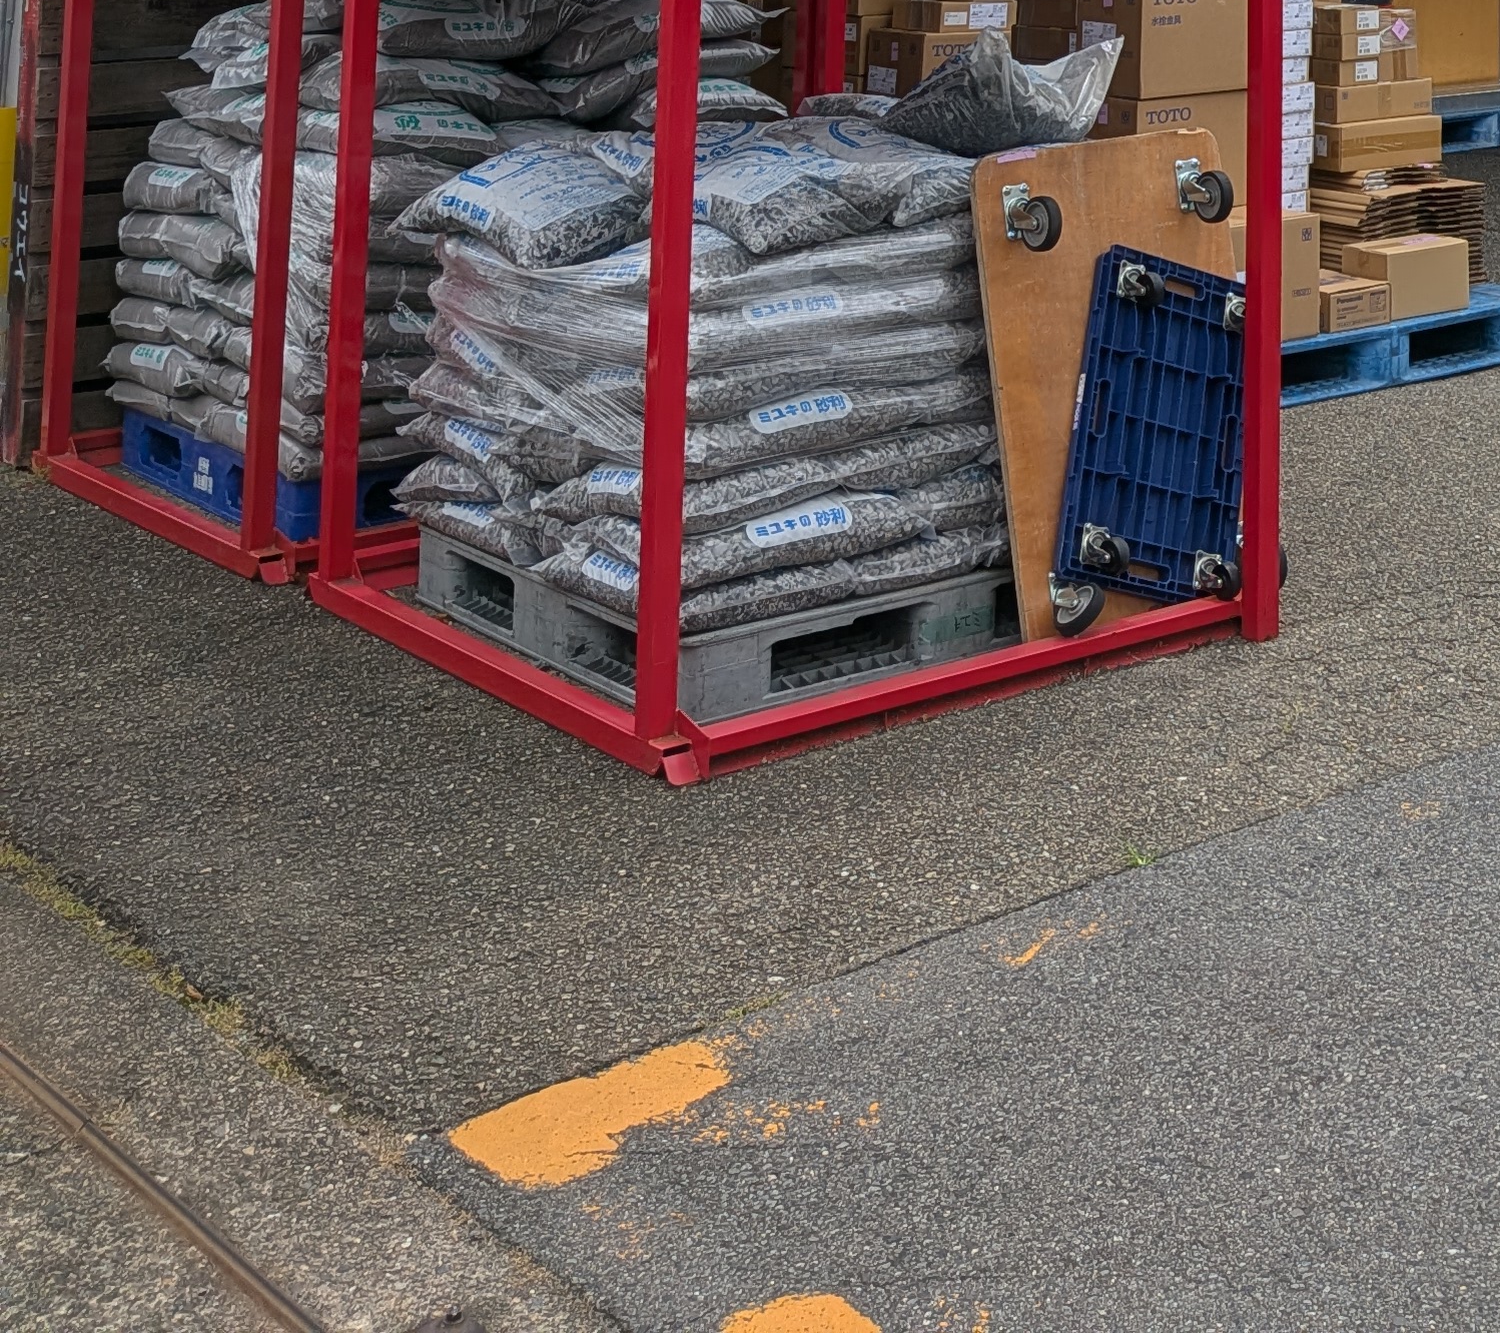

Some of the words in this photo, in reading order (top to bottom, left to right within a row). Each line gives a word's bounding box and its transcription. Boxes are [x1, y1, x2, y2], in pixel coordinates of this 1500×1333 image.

[1146, 107, 1192, 125] TOTO
[754, 507, 847, 537] ミユキの砂利
